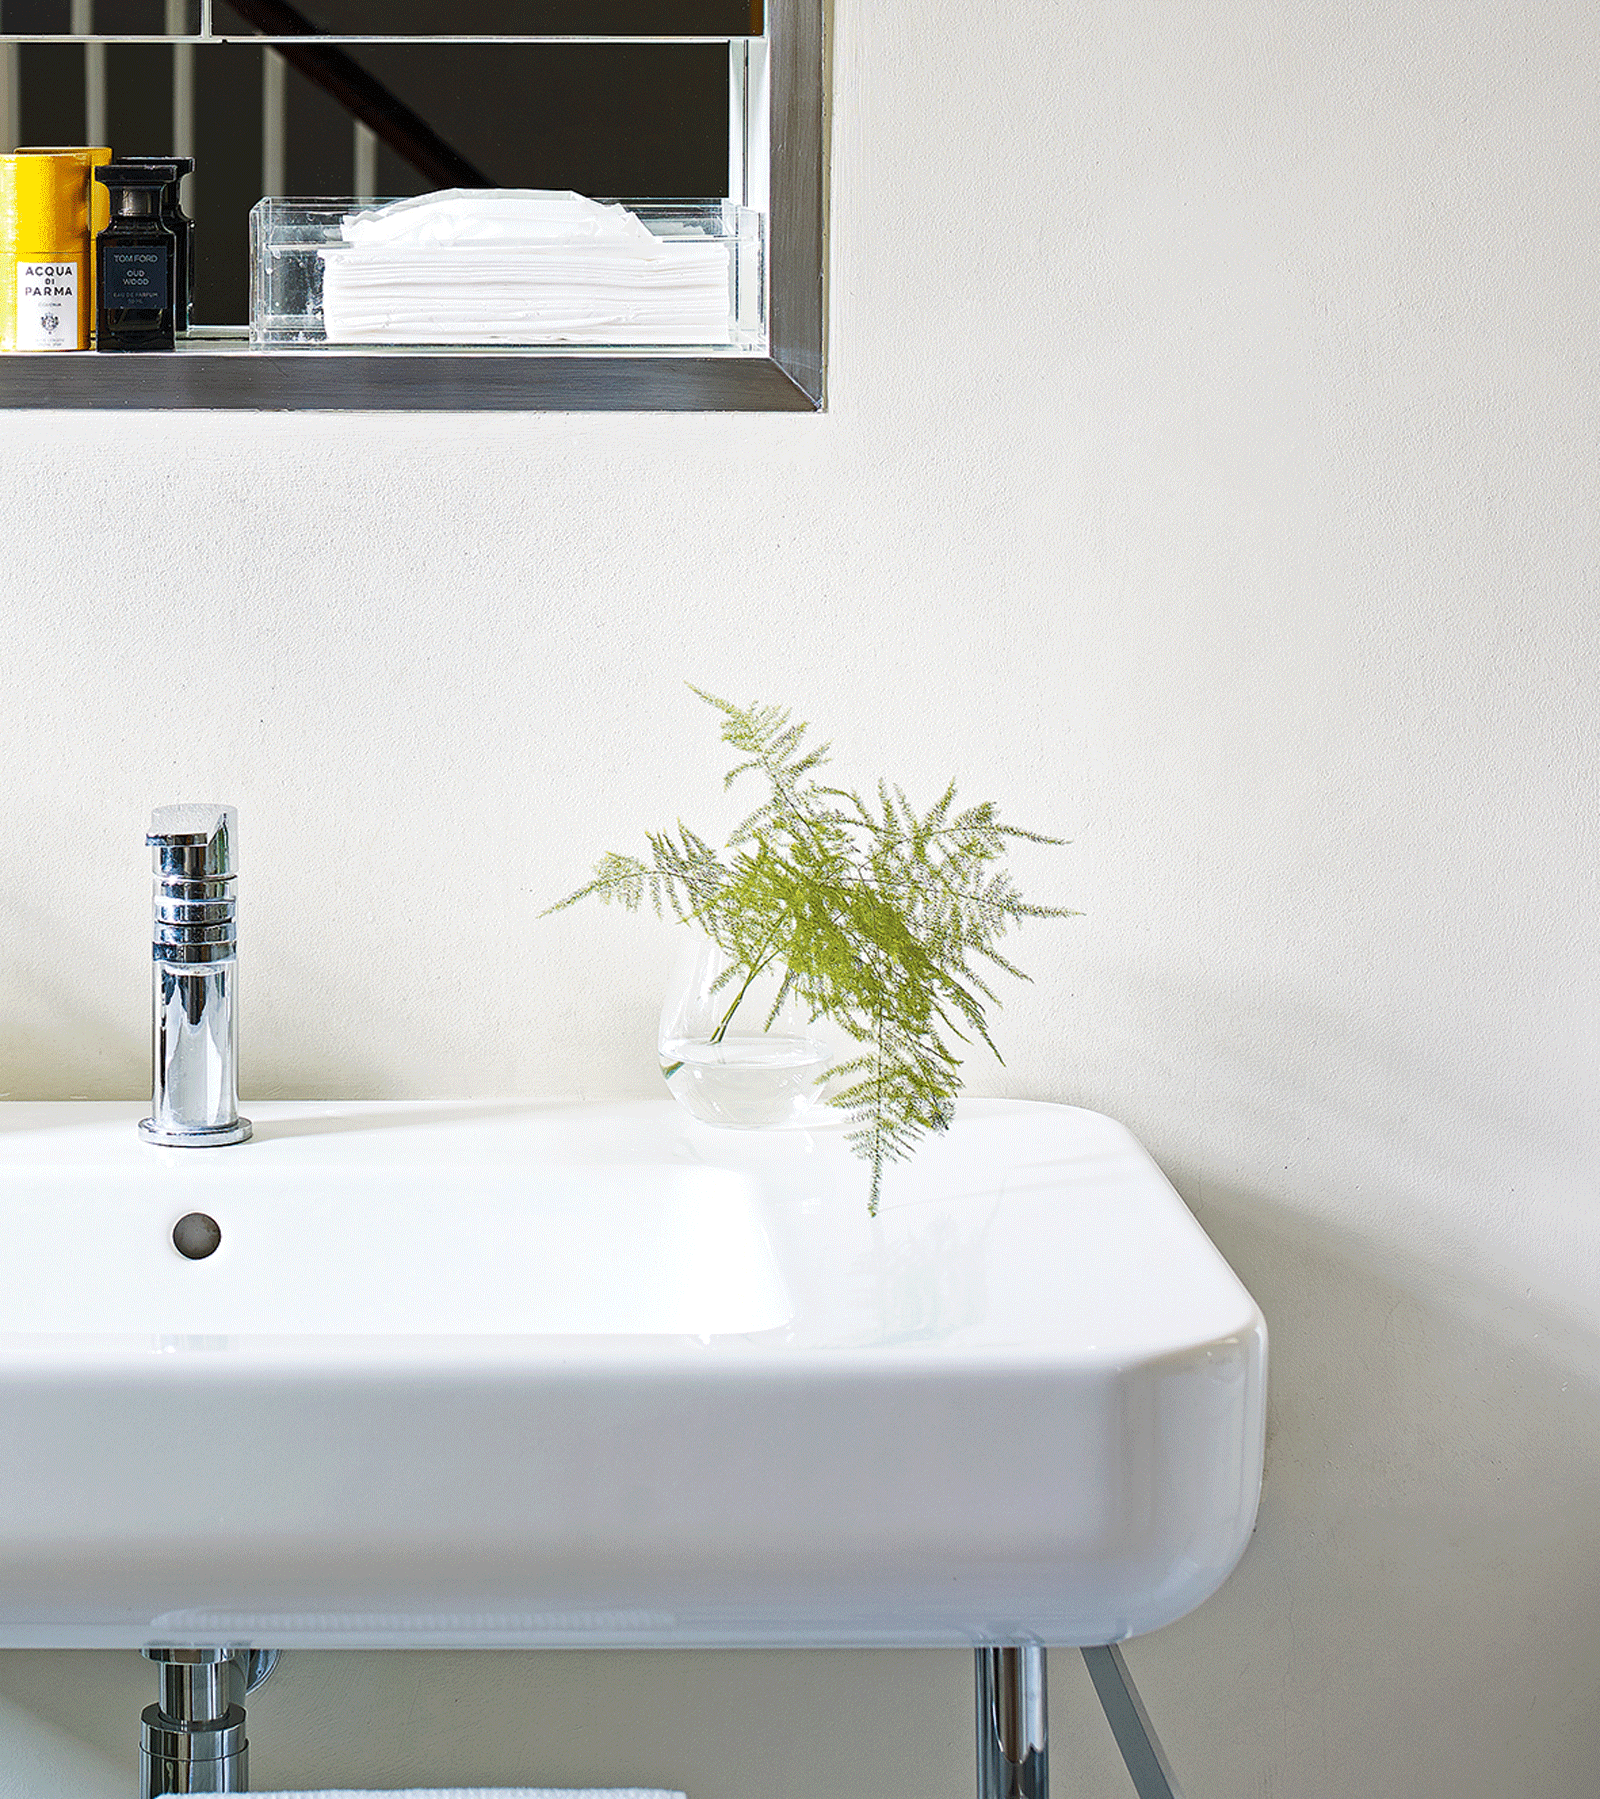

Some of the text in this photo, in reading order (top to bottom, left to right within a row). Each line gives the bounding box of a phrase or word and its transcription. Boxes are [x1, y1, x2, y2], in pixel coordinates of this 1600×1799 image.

[113, 254, 158, 263] TOM FORD
[25, 266, 73, 276] ACQUA
[122, 278, 149, 286] WOOD
[25, 287, 73, 296] PARMA
